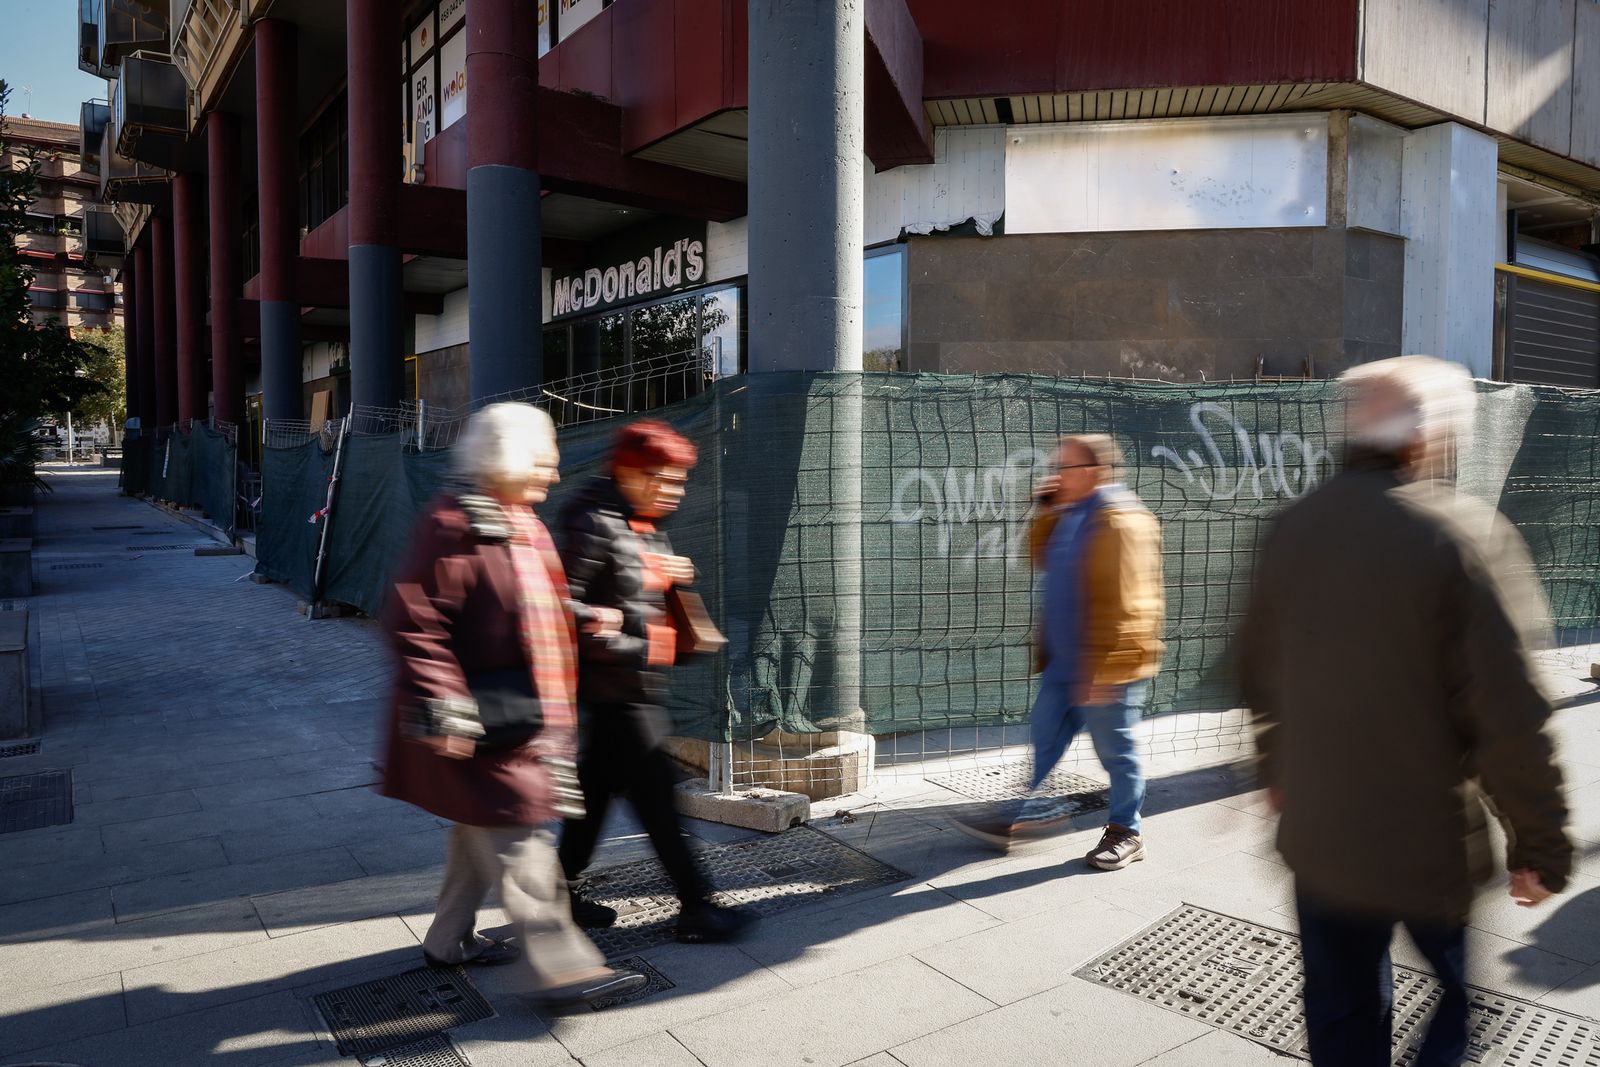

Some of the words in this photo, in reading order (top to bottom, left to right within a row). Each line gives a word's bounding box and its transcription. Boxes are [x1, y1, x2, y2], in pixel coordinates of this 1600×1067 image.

[416, 76, 427, 101] BR
[417, 95, 433, 121] AND
[552, 237, 704, 317] McDonald's
